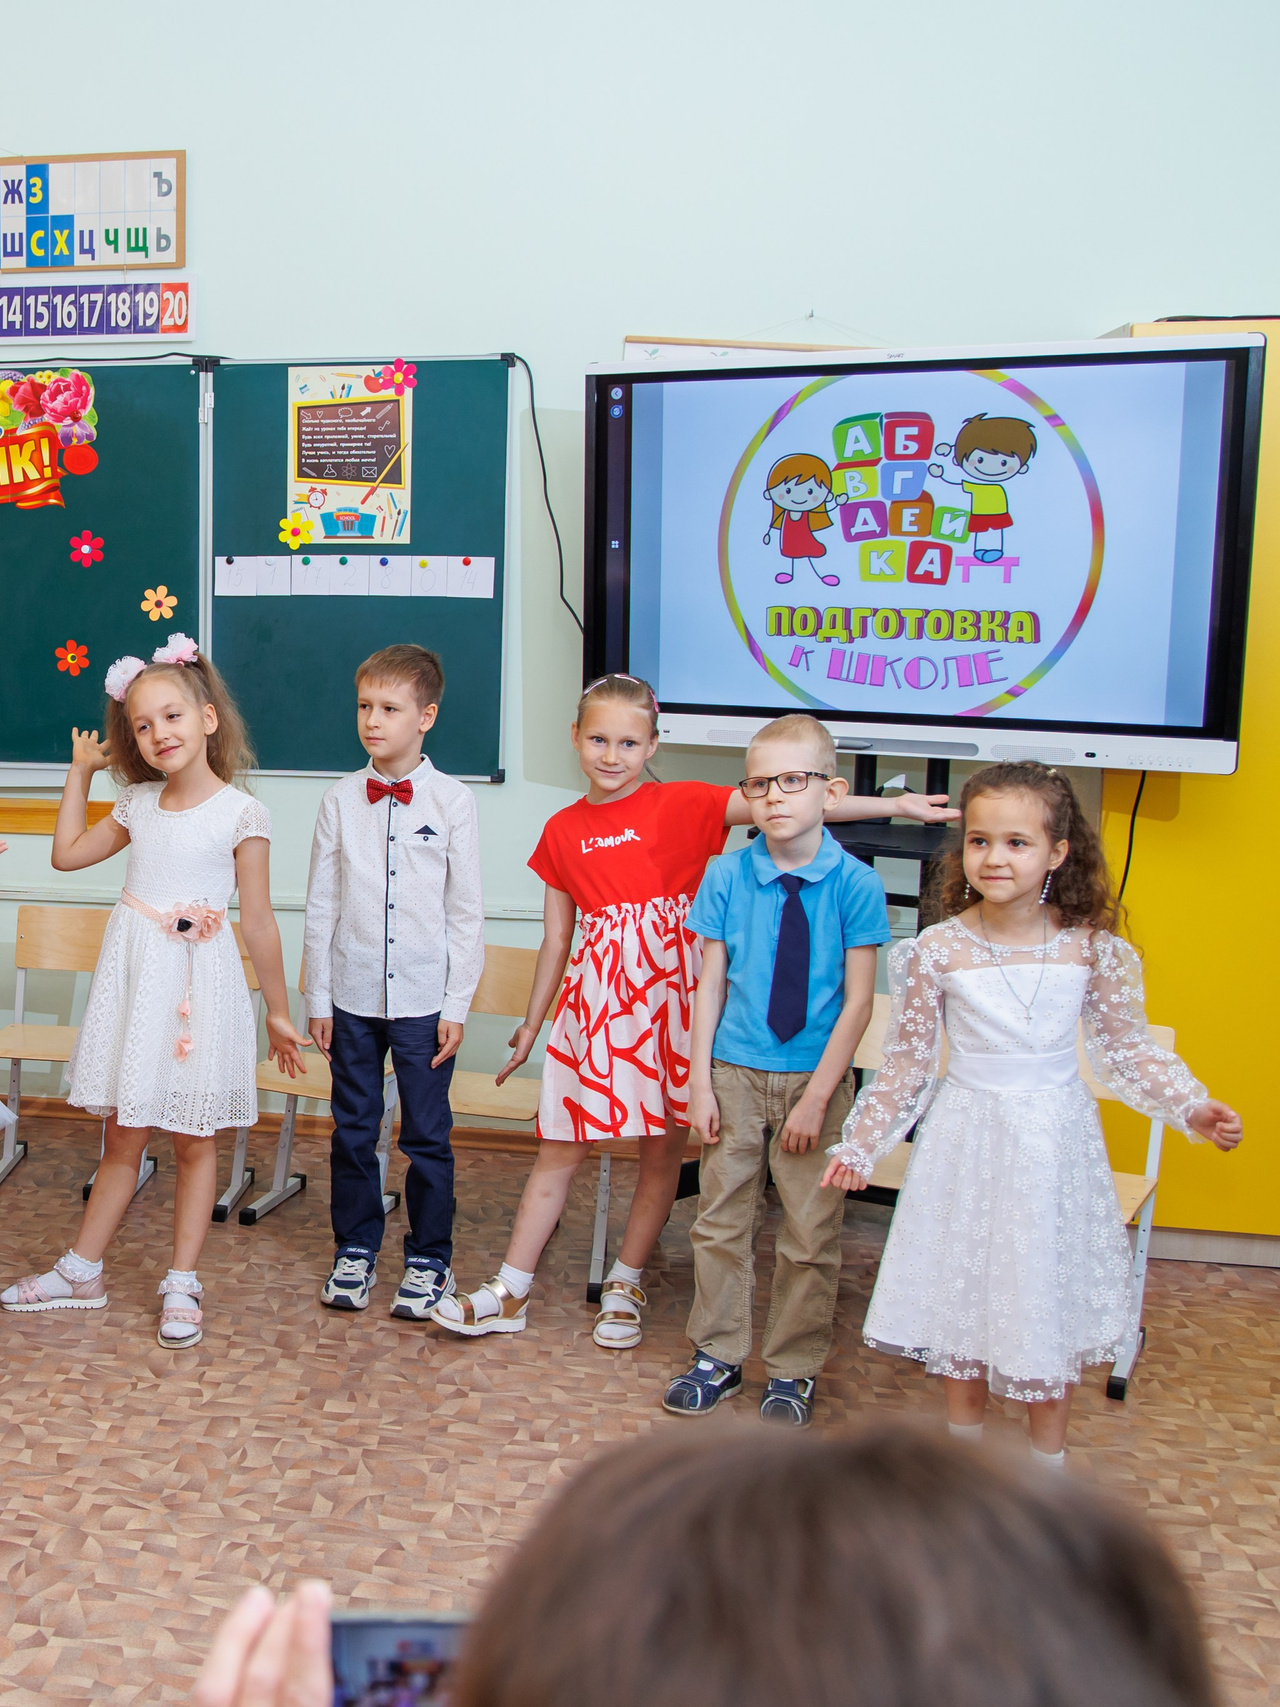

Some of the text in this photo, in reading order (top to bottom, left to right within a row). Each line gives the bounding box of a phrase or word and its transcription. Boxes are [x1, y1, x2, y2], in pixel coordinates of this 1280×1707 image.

[0, 296, 22, 329] 14
[26, 295, 48, 329] 15
[53, 294, 77, 328] 16
[80, 294, 103, 328] 17
[107, 292, 130, 327] 18
[135, 292, 159, 327] 19
[162, 291, 186, 325] 20
[766, 606, 1040, 643] ПОДГОТОВКА
